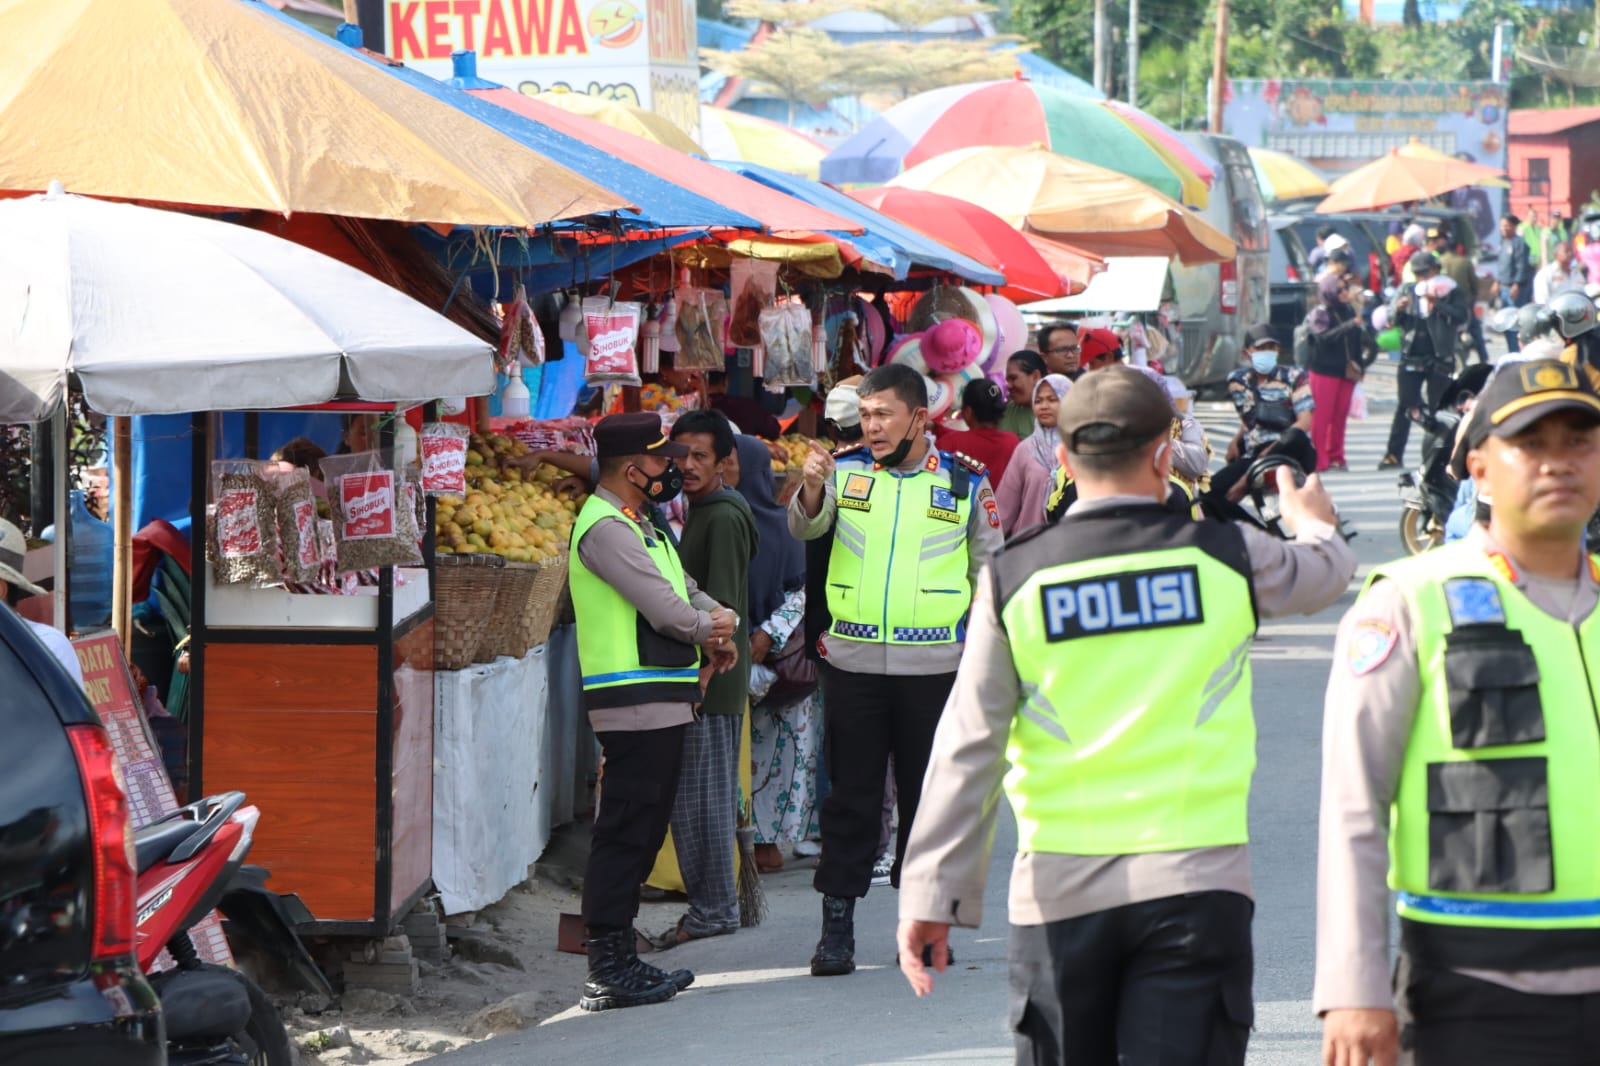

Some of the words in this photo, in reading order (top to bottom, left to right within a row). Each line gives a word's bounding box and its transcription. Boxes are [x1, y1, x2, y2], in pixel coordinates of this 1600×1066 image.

[390, 0, 588, 60] KETAWA
[592, 336, 630, 356] SIHOBUK
[350, 496, 386, 518] SIHOBUK
[1045, 571, 1198, 636] POLISI
[76, 643, 115, 673] DATA
